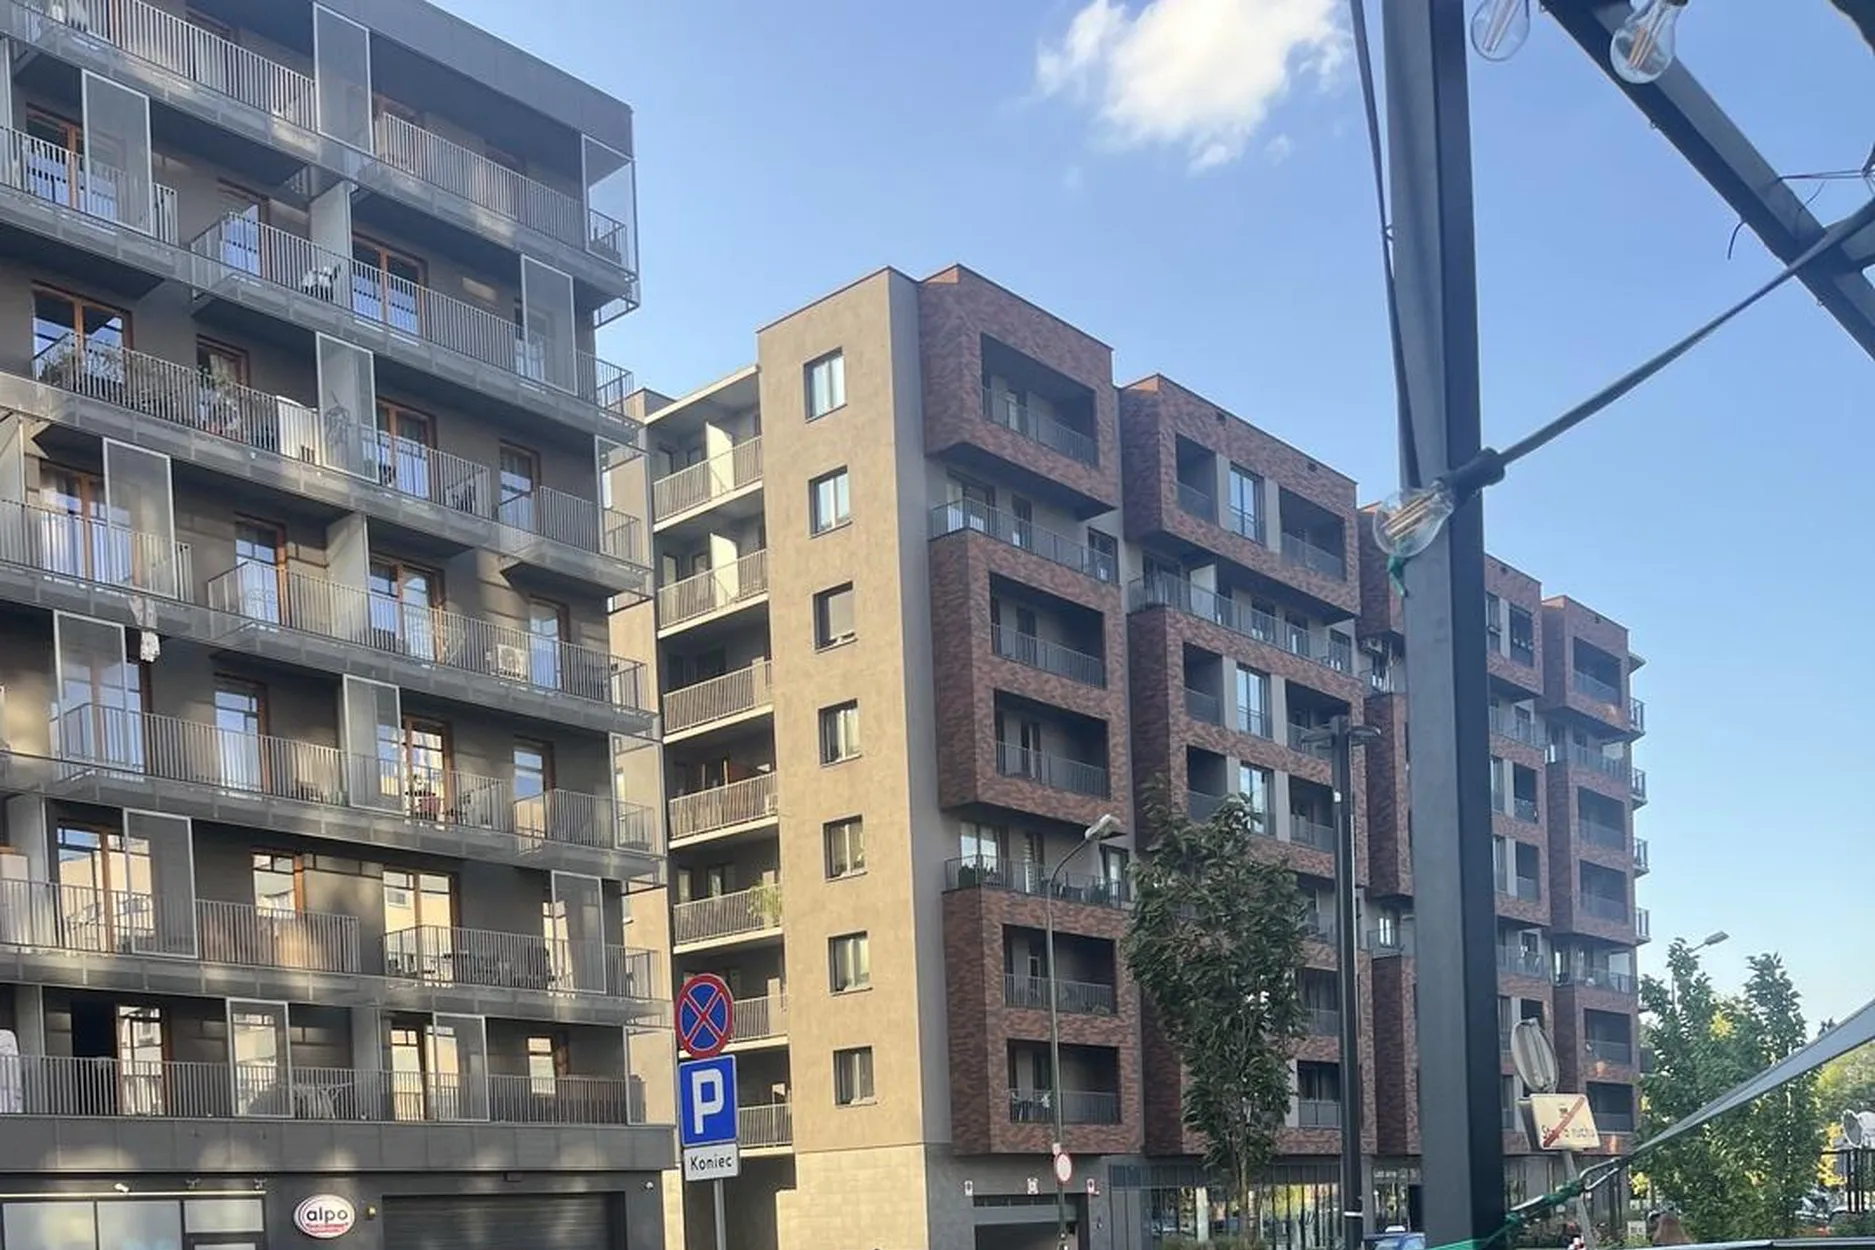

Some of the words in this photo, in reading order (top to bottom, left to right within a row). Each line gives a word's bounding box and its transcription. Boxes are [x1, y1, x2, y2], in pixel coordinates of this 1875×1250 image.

[691, 1068, 725, 1135] P
[690, 1154, 732, 1171] Koniec
[306, 1206, 348, 1225] alpo
